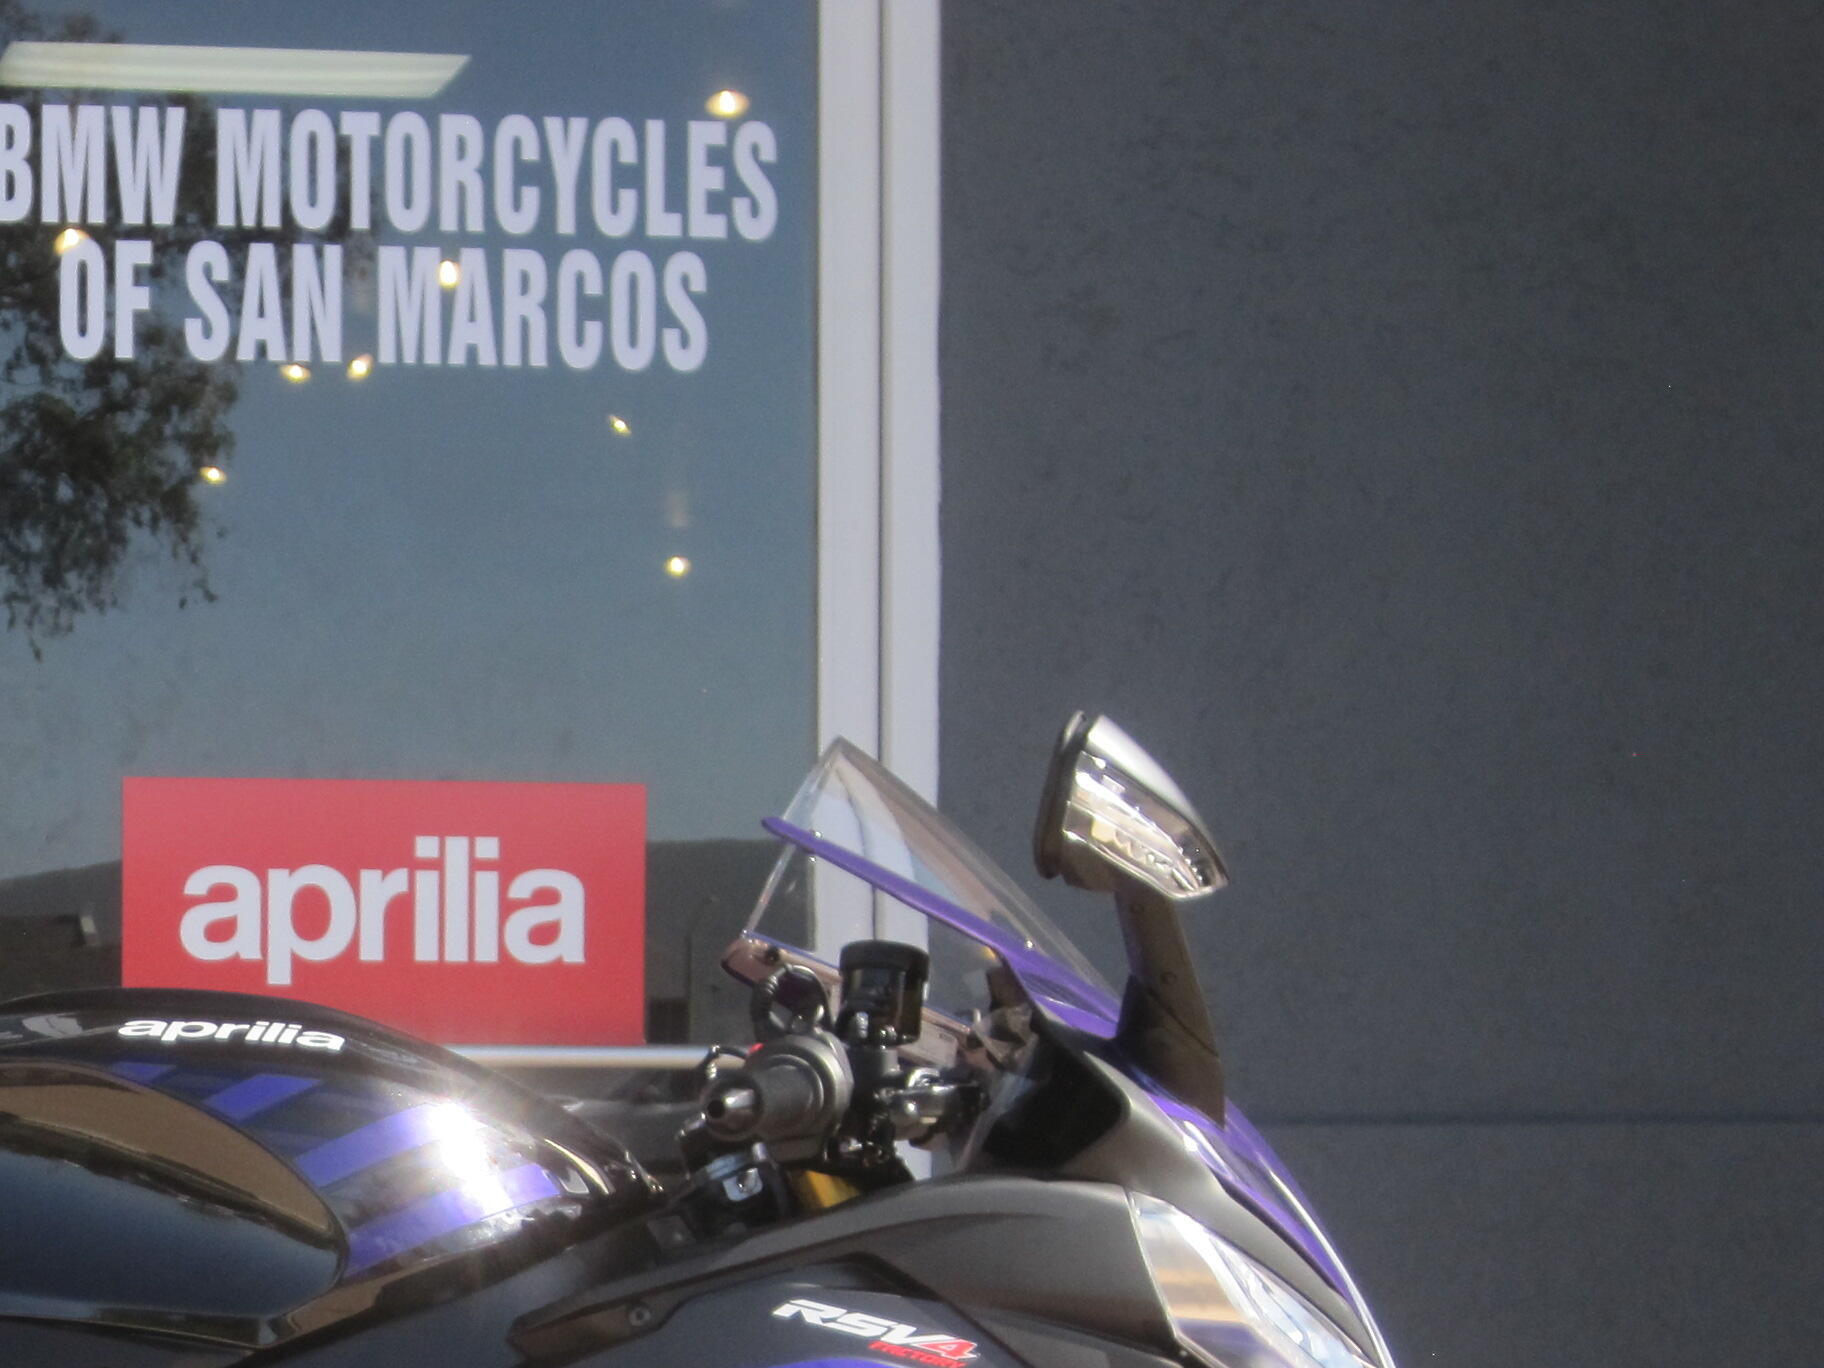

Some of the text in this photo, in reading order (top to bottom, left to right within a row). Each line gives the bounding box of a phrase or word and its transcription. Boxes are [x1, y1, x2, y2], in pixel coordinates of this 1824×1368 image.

[217, 109, 778, 242] MOTORCYCLES
[58, 239, 708, 373] OF SAN MARCOS
[179, 835, 586, 986] aprilia
[117, 1019, 346, 1051] aprilia
[772, 1299, 979, 1361] RSV4
